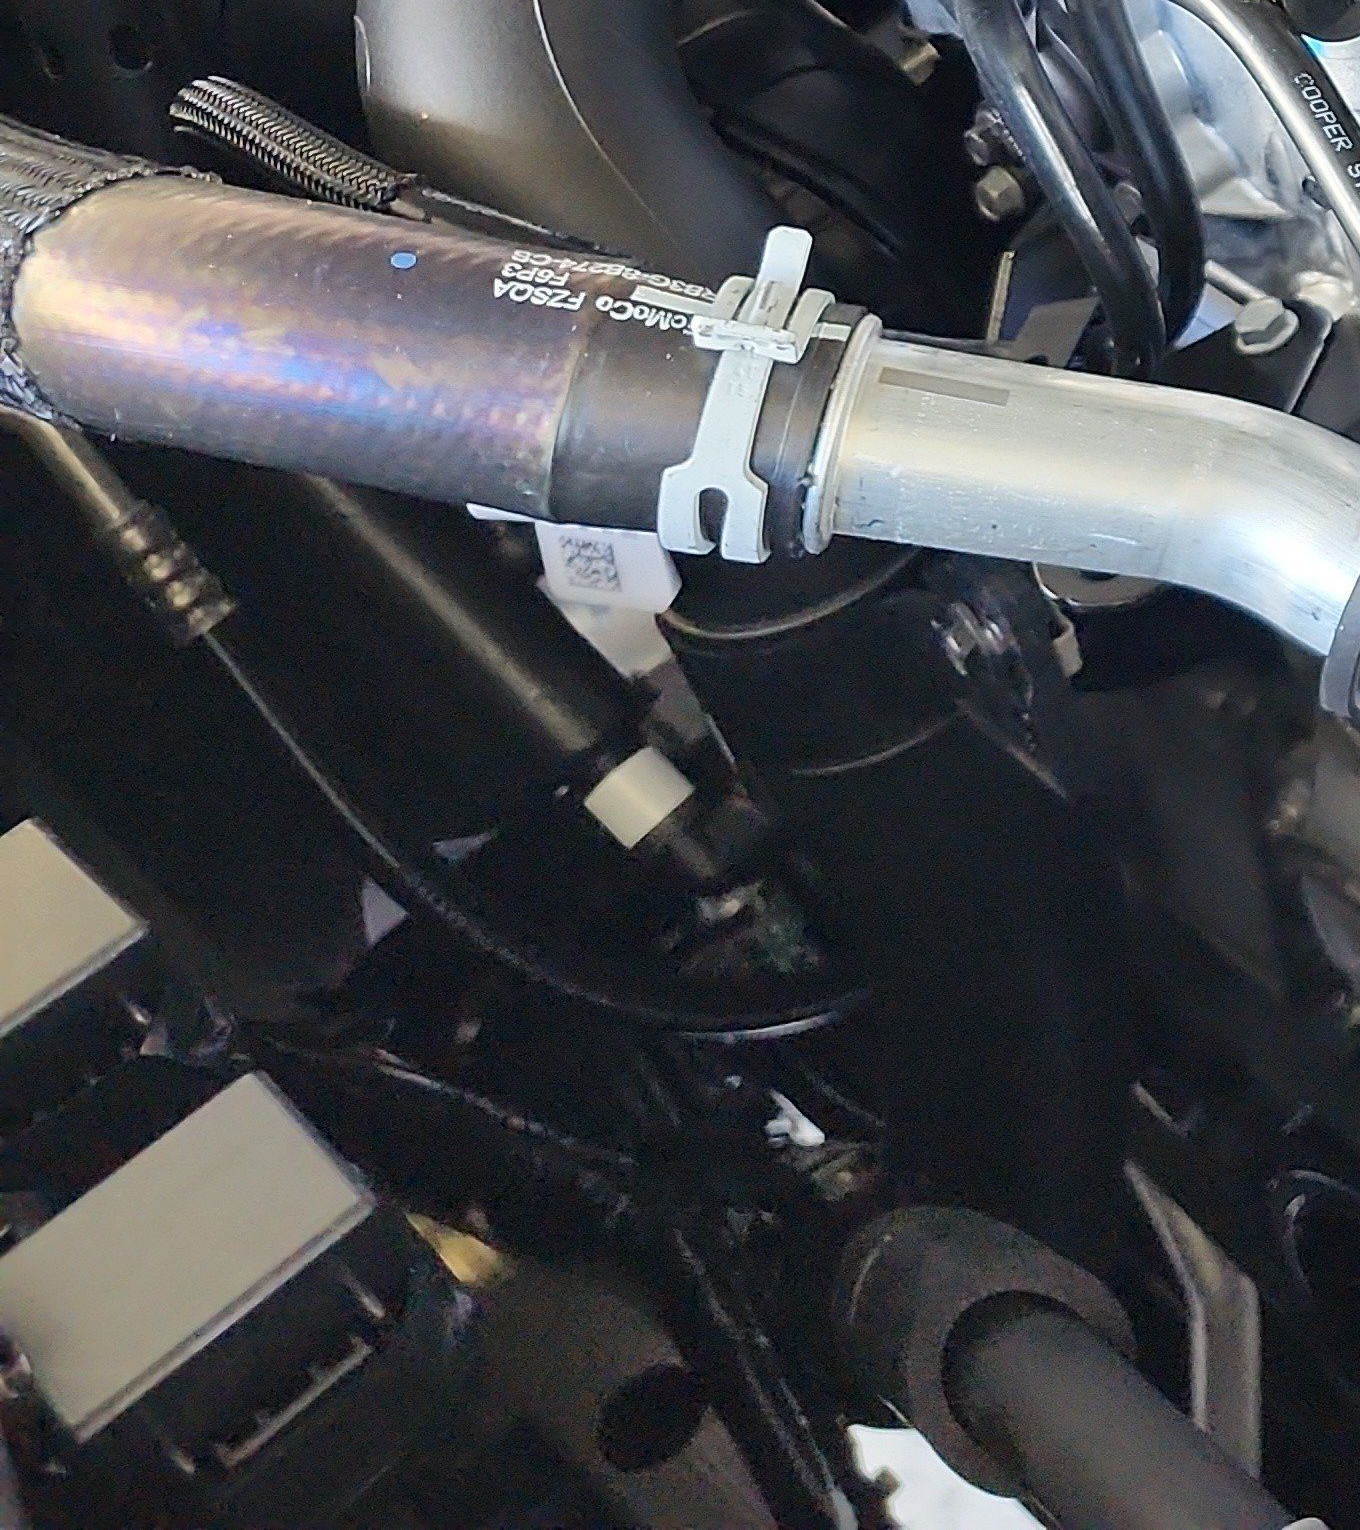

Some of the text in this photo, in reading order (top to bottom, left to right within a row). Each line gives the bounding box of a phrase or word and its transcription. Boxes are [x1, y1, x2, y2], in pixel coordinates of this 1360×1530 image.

[1294, 73, 1354, 152] COOPER
[501, 262, 570, 287] F6P3
[494, 278, 588, 312] FZSQA
